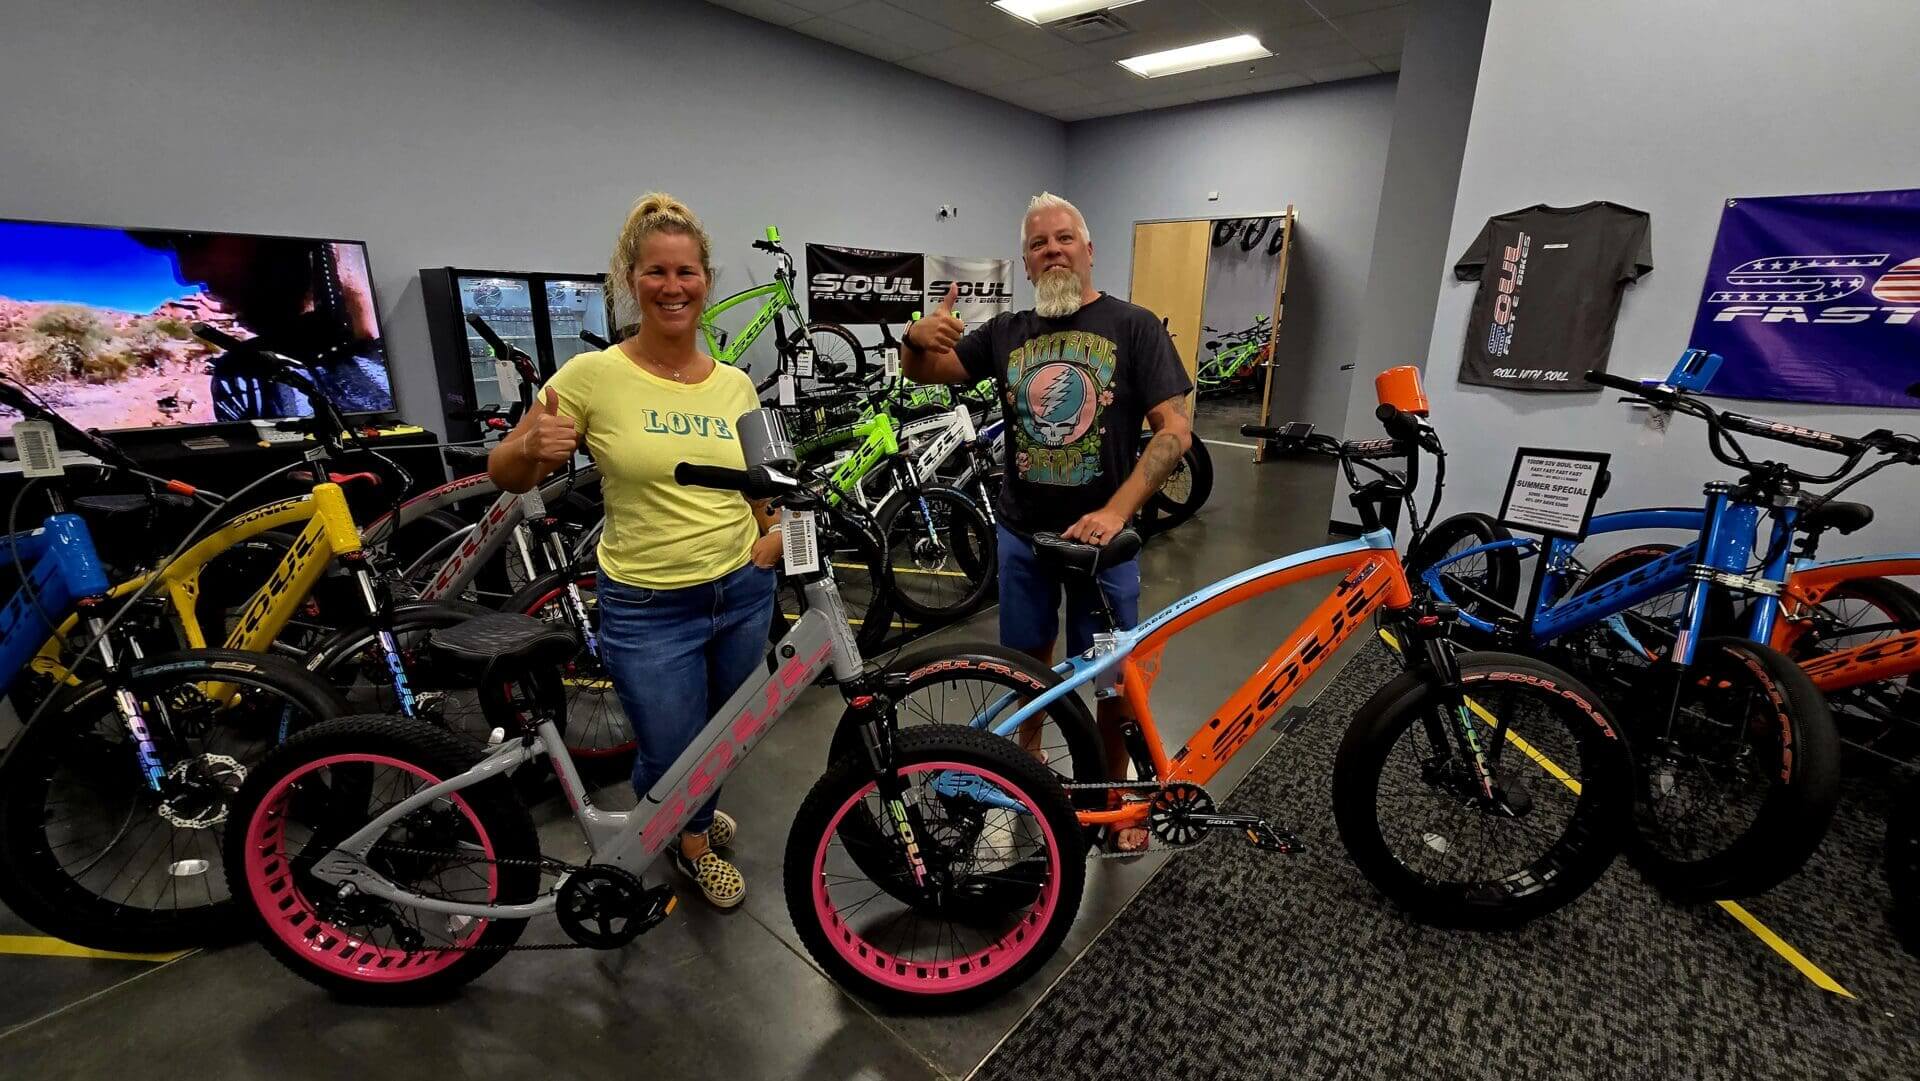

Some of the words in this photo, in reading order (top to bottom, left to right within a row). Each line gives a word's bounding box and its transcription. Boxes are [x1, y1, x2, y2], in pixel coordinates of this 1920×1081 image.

[810, 272, 923, 295] SOUL
[813, 293, 857, 301] FAST
[860, 293, 872, 301] E
[880, 294, 920, 302] BIKES
[927, 280, 1013, 297] SOUL
[1488, 231, 1524, 357] SOUL
[1503, 311, 1516, 355] FAST
[1516, 235, 1531, 286] BIKES
[1713, 306, 1920, 324] FAST
[1007, 330, 1117, 388] GRATEFUL
[1493, 367, 1517, 378] ROLL
[642, 409, 734, 440] LOVE
[1025, 447, 1084, 486] DEAD
[1516, 479, 1550, 491] SUMMER
[1551, 484, 1588, 496] SPECIAL
[233, 499, 297, 528] SONIC
[1176, 595, 1197, 609] PRO
[379, 631, 416, 719] SOUL
[909, 660, 977, 681] SOUL
[978, 660, 1046, 690] FAST
[1212, 576, 1391, 761] SOUL
[1488, 671, 1560, 694] SOUL
[1561, 690, 1618, 740] FAST
[116, 689, 166, 792] SOUL
[640, 638, 832, 855] SOUL
[1459, 705, 1494, 799] SOUL
[890, 799, 927, 887] SOUL
